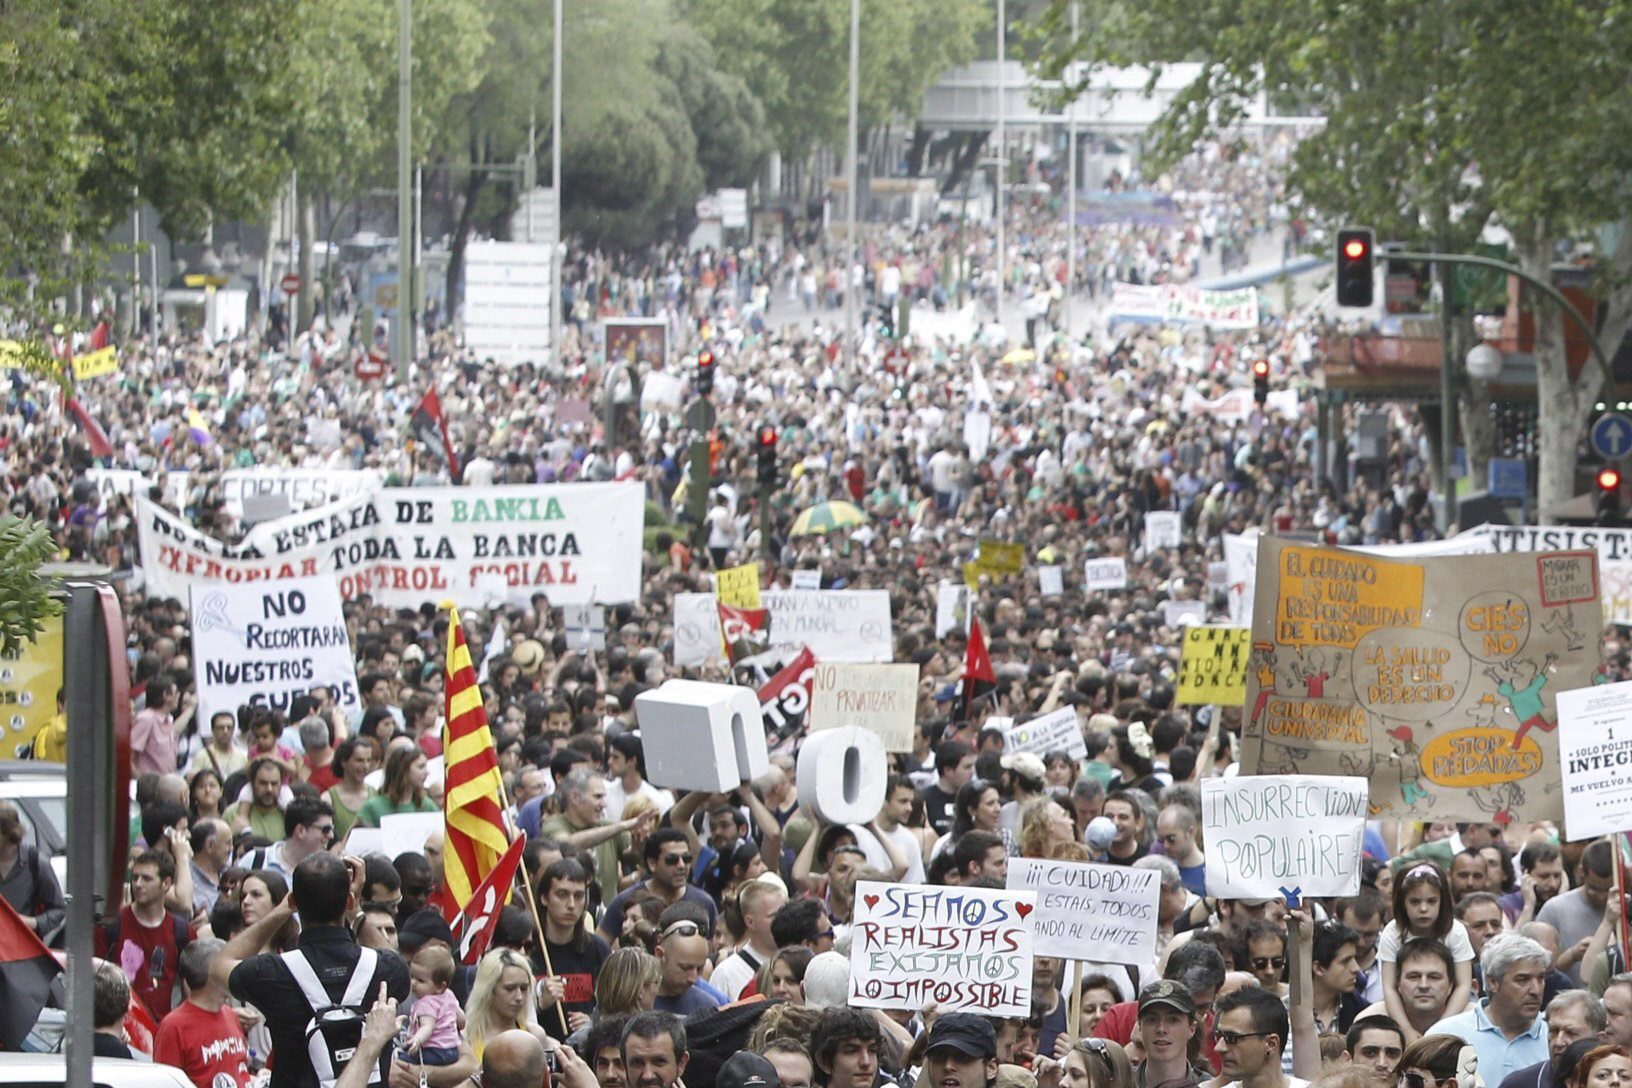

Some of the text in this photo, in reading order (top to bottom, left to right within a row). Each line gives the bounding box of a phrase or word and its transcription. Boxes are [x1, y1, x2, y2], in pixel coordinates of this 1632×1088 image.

[395, 500, 433, 524] DE
[451, 496, 566, 523] BANKIA
[332, 536, 401, 570] TODA
[414, 535, 456, 560] LA
[473, 532, 582, 558] BANCA
[340, 565, 448, 600] ONTROL
[1287, 554, 1378, 585] EL CUIDADO
[262, 590, 306, 619] NO
[1304, 582, 1359, 604] ES UNA
[1286, 597, 1419, 626] RESPONSABILIDAD
[1281, 621, 1304, 640] DE
[1364, 646, 1451, 666] LA SALUD
[1483, 634, 1518, 656] NO
[206, 657, 314, 686] NUESTROS
[815, 665, 836, 691] NO
[1378, 665, 1443, 686] ES UN
[1367, 684, 1455, 705] DERECHO
[1267, 718, 1369, 745] UNIVERSAL
[1607, 727, 1614, 740] 1
[1449, 736, 1505, 755] STOP
[1576, 746, 1599, 758] SOLO
[1432, 751, 1539, 778] REDADAS
[1570, 784, 1585, 794] ME
[1587, 778, 1624, 791] VUELVO
[1626, 777, 1632, 785] A
[879, 887, 1011, 926] SEAMOS
[854, 922, 1026, 953] REALISTAS
[1069, 923, 1084, 938] AL
[868, 951, 1026, 982] EXIJAMOS
